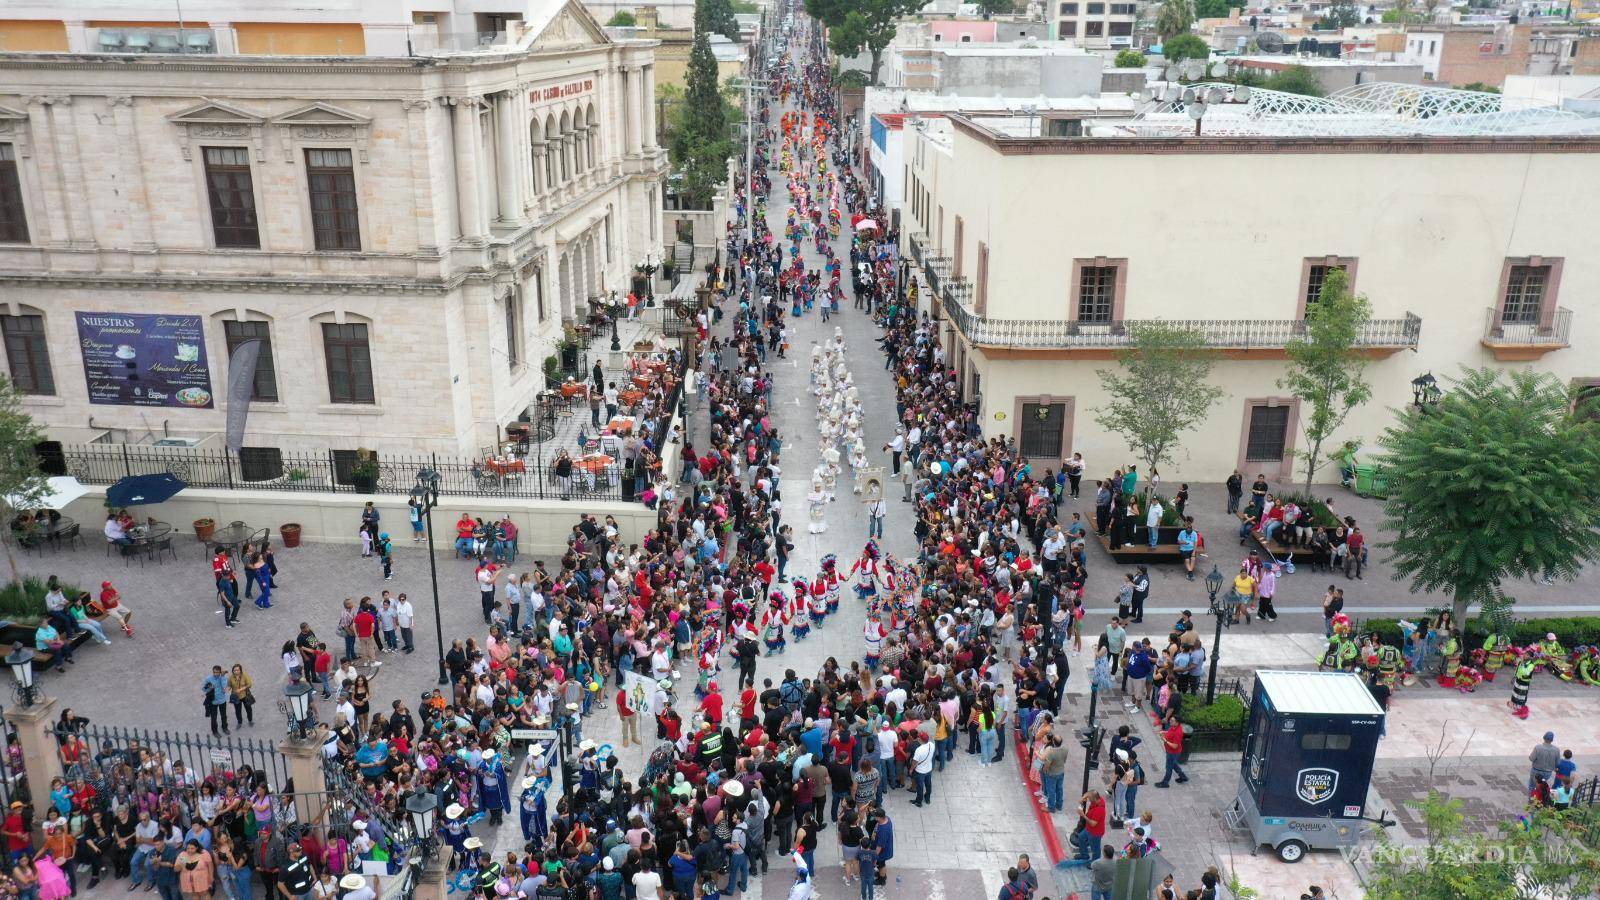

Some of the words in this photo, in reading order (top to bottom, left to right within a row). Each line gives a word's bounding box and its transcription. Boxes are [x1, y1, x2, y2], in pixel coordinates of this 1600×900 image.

[544, 86, 560, 101] CASINO
[564, 82, 582, 96] SALTILLO
[82, 318, 134, 327] NUESTRAS
[98, 326, 142, 336] promociones
[148, 362, 180, 372] Meriendas
[189, 363, 206, 373] Cenas
[1288, 820, 1327, 829] COAHUILA
